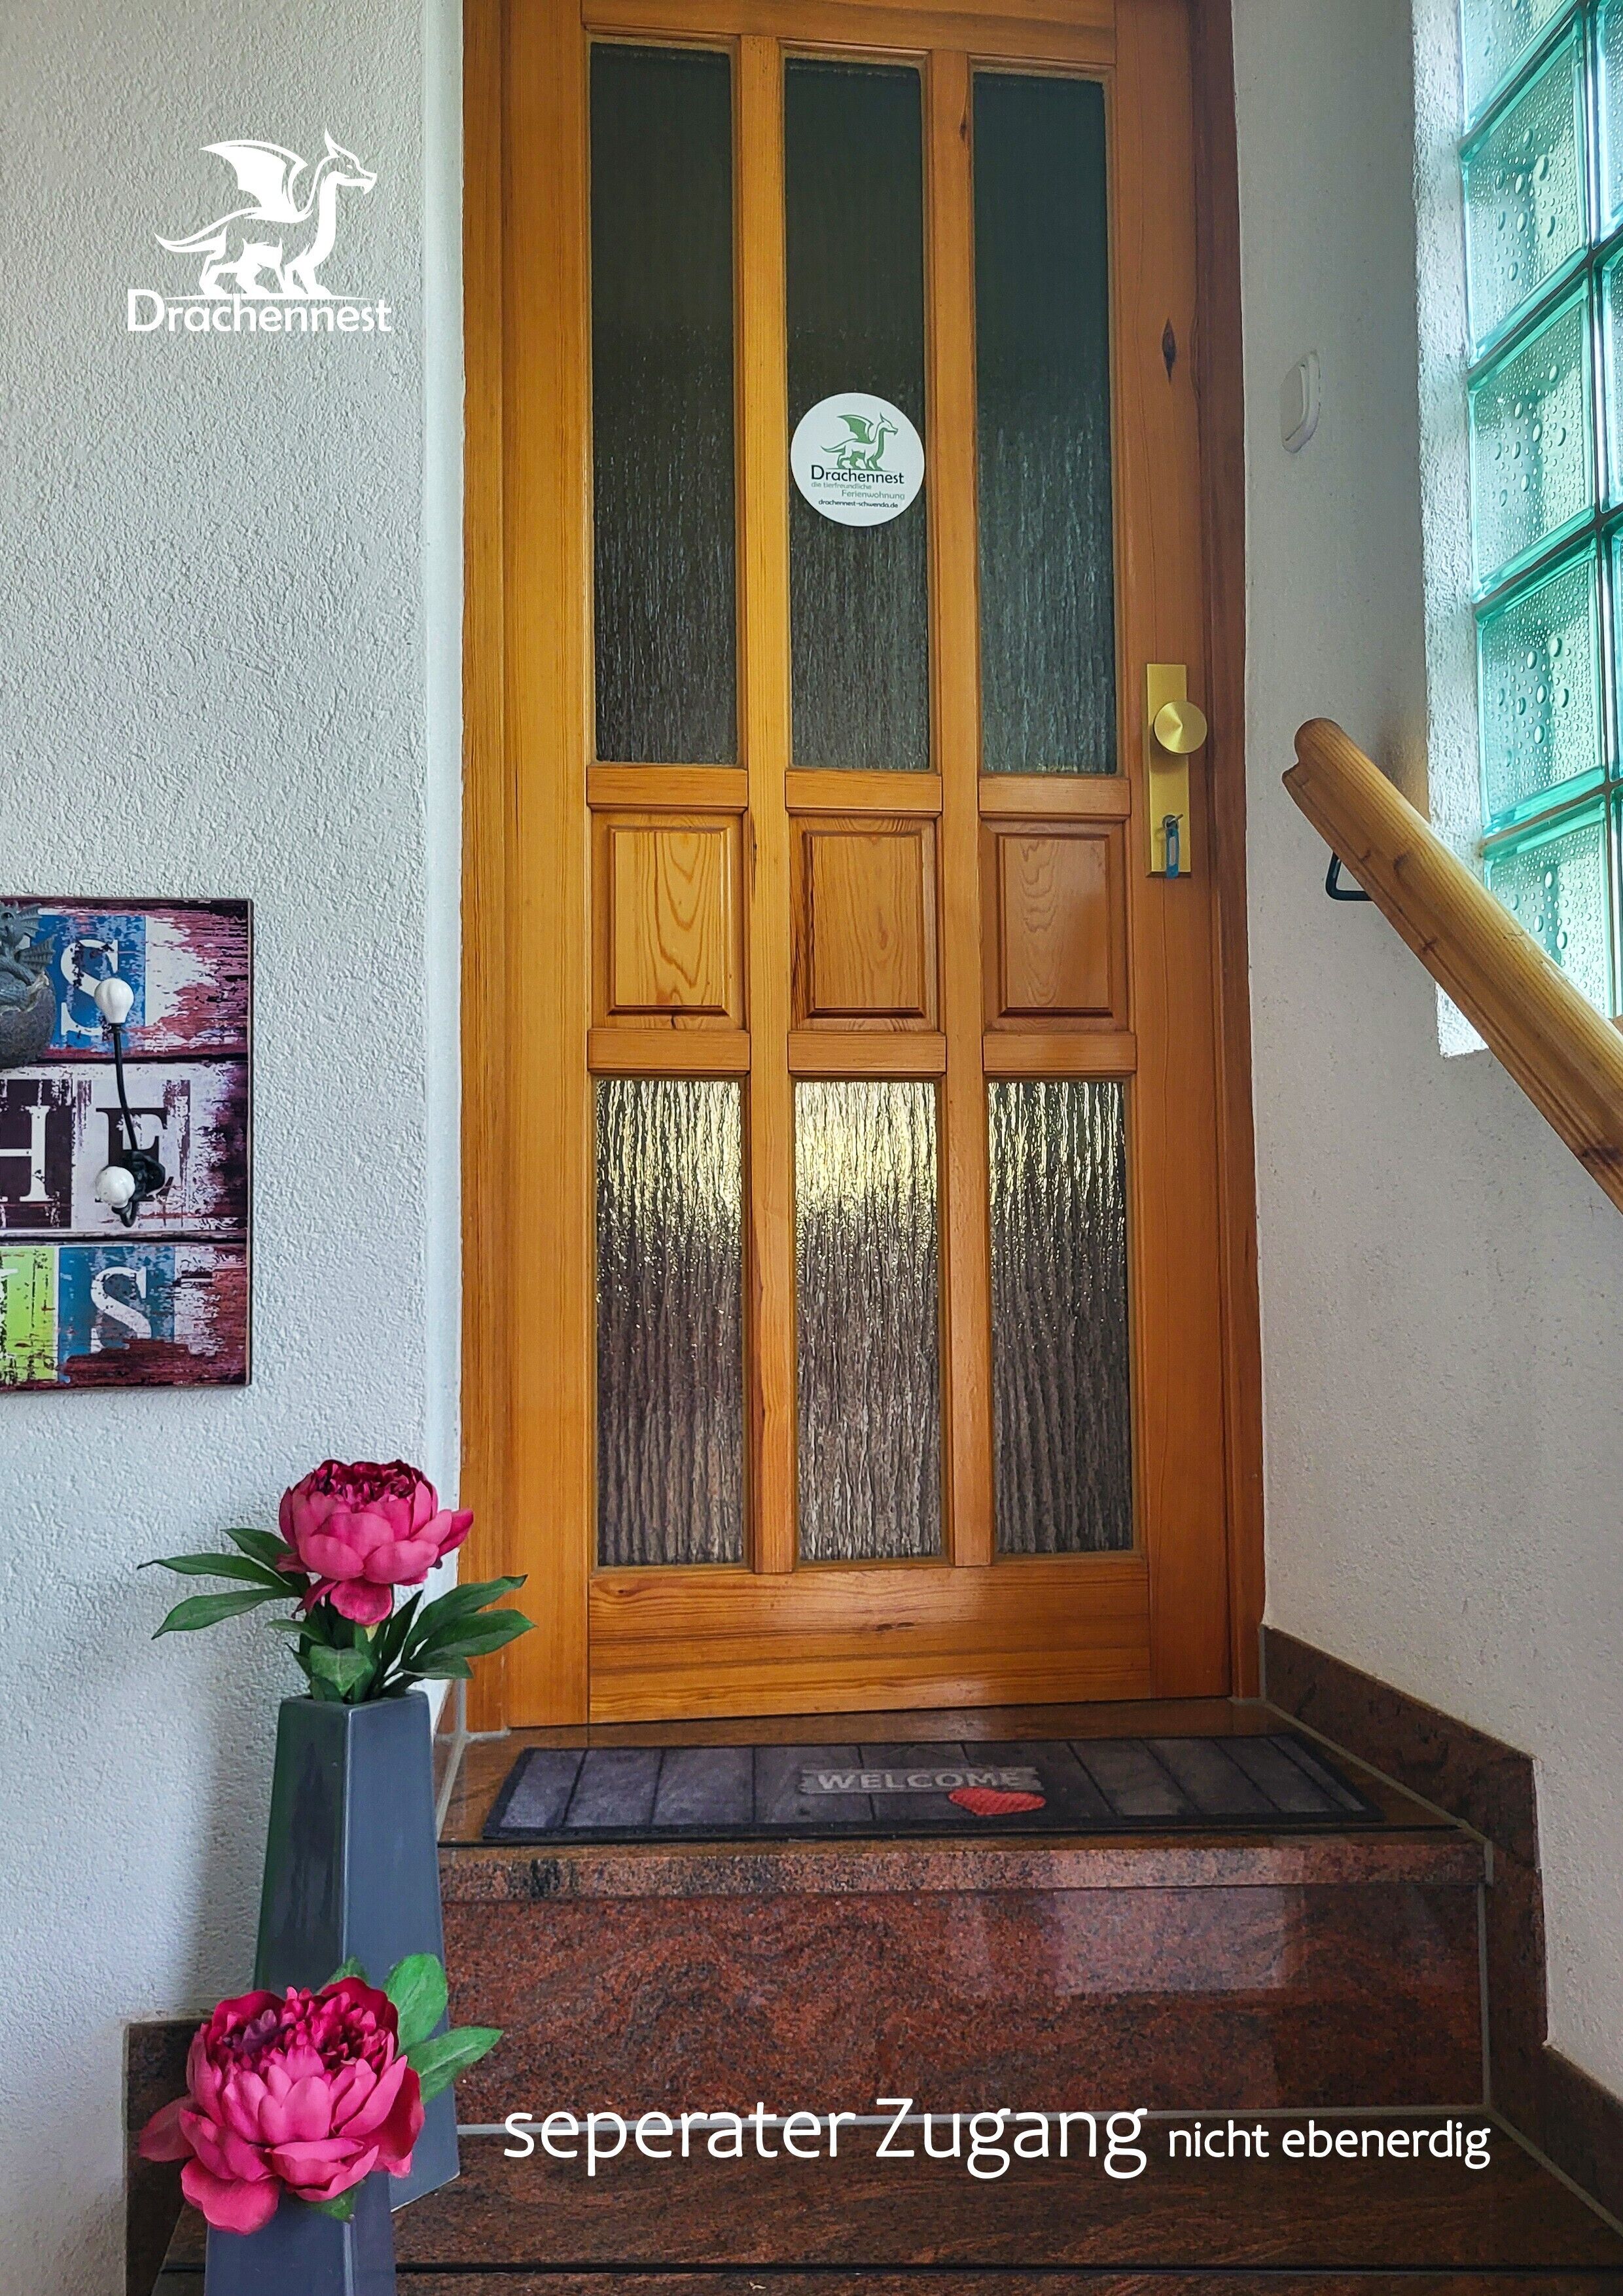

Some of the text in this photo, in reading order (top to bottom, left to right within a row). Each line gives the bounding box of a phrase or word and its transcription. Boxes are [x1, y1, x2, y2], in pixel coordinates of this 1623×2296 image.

[811, 465, 904, 484] Drachennest
[842, 490, 904, 499] Ferienwohnung
[818, 499, 899, 508] drachennest-schwenda.de
[818, 1772, 1023, 1790] WELCOME
